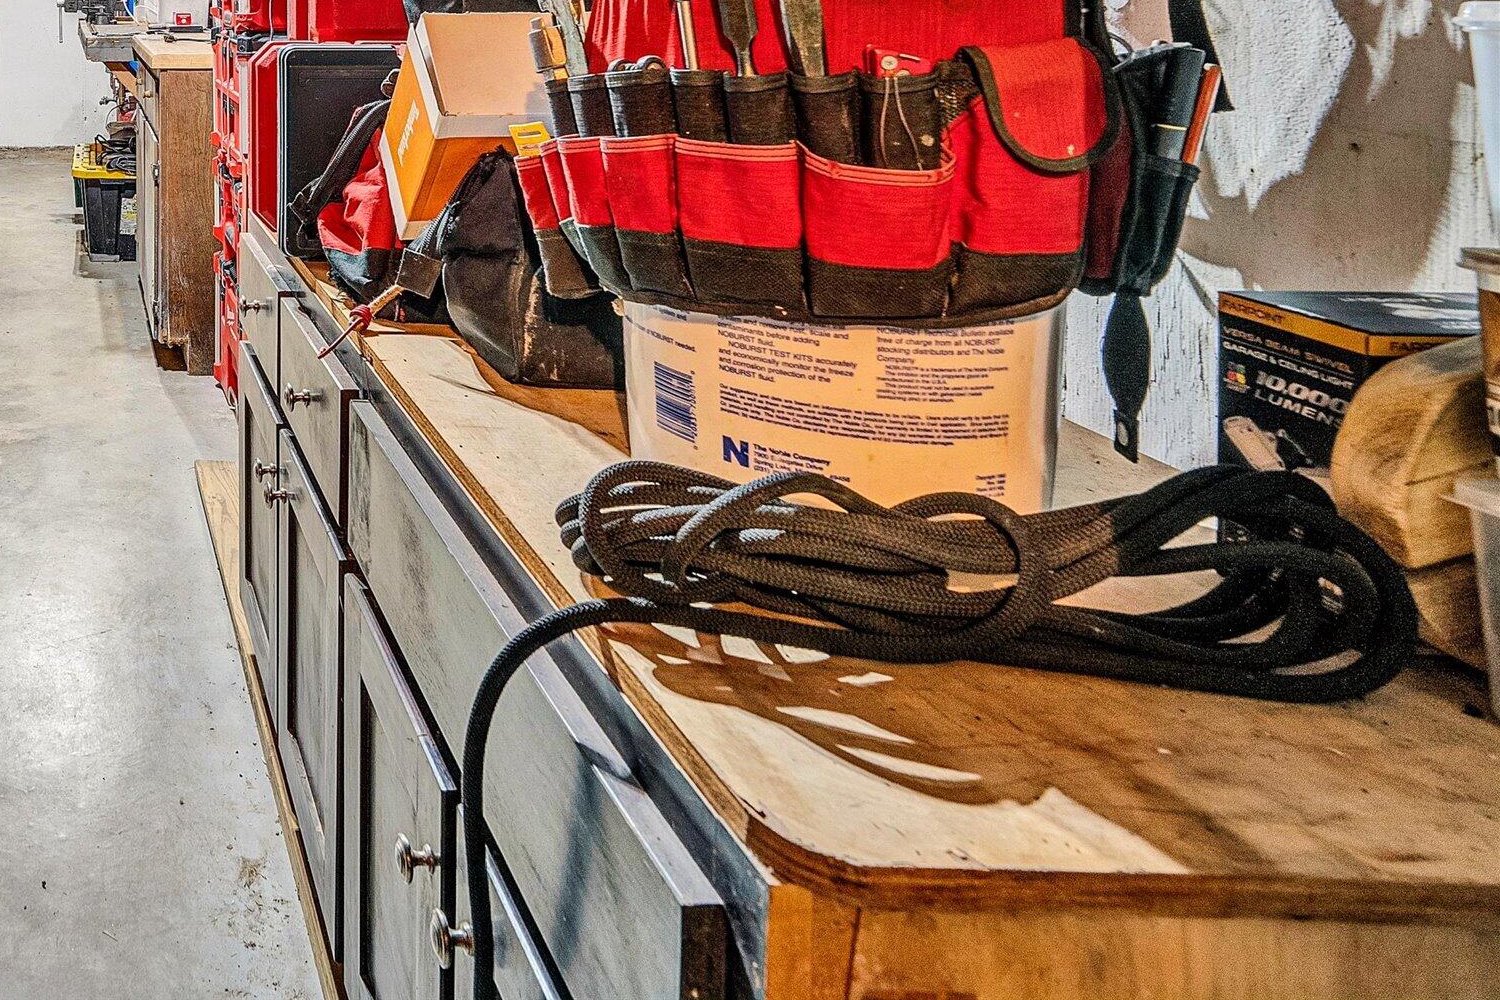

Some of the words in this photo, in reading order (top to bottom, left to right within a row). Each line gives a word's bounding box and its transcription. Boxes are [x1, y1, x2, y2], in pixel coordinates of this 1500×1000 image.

[718, 329, 755, 343] NOBURST
[766, 331, 790, 341] before
[793, 336, 820, 347] adding
[905, 338, 932, 347] charge
[728, 340, 766, 354] NOBURST
[769, 349, 790, 359] TEST
[793, 353, 813, 362] KITS
[815, 357, 857, 369] accurately
[876, 346, 910, 355] stocking
[912, 348, 954, 356] distributors
[1222, 340, 1269, 362] GARAGE
[719, 347, 731, 356] and
[733, 351, 779, 367] economically
[781, 361, 811, 371] monitor
[814, 364, 826, 373] the
[828, 367, 854, 377] freeze
[719, 356, 731, 364] and
[733, 360, 766, 372] corrosion
[768, 367, 806, 379] protection
[818, 375, 831, 383] the
[719, 364, 756, 379] NOBURST
[752, 443, 767, 452] The
[769, 447, 791, 458] Noble
[793, 452, 830, 466] Company
